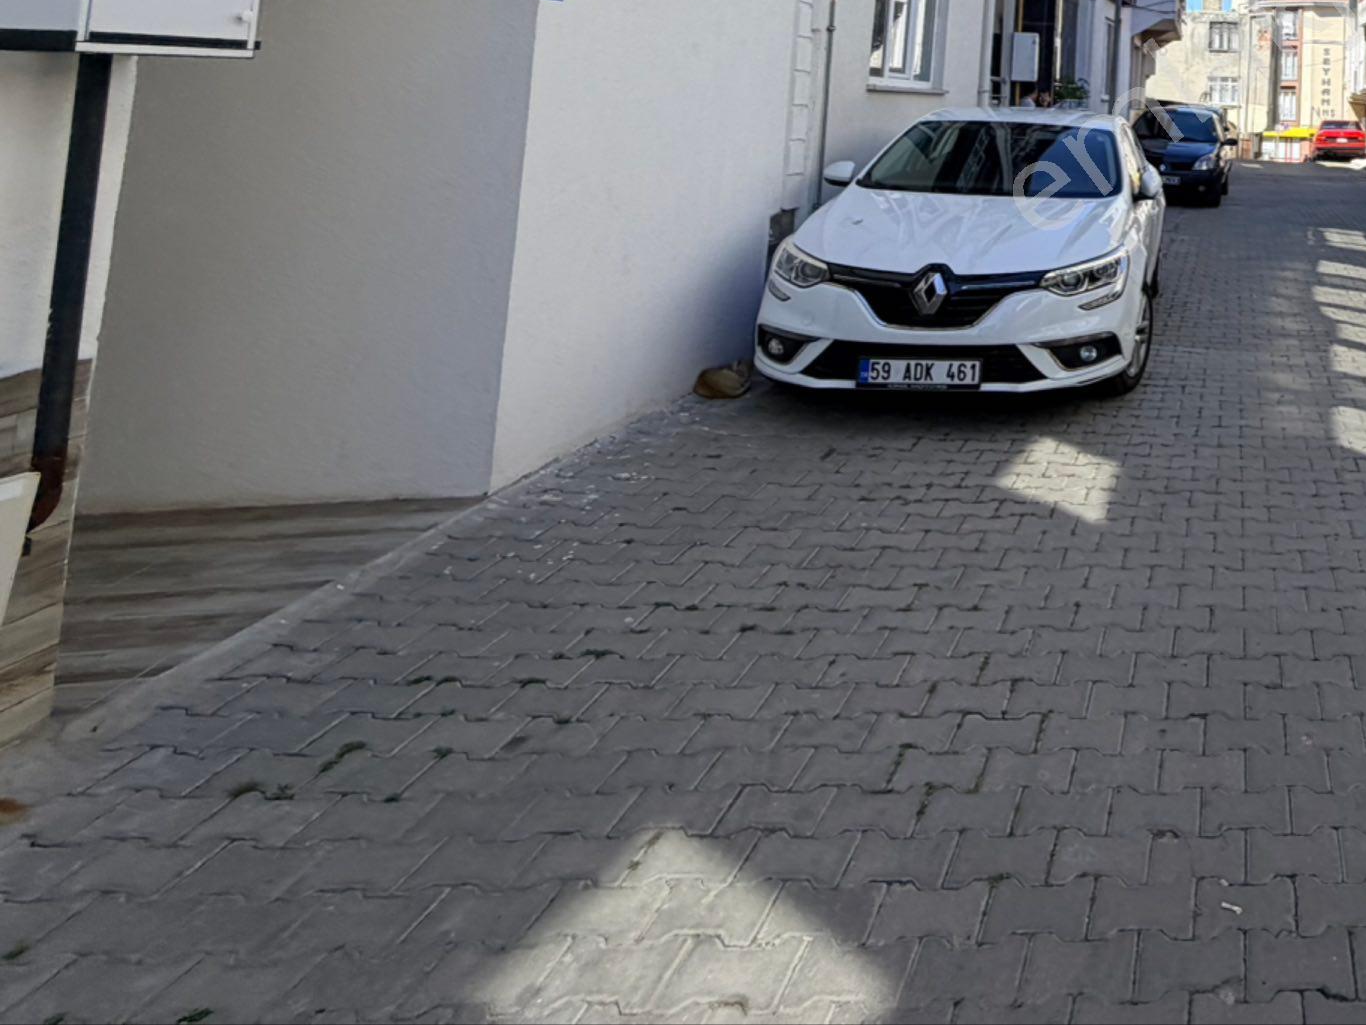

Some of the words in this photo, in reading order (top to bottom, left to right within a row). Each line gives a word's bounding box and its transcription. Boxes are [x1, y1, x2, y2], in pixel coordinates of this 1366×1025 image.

[870, 362, 891, 380] 59
[902, 362, 934, 381] ADK
[945, 363, 977, 382] 461
